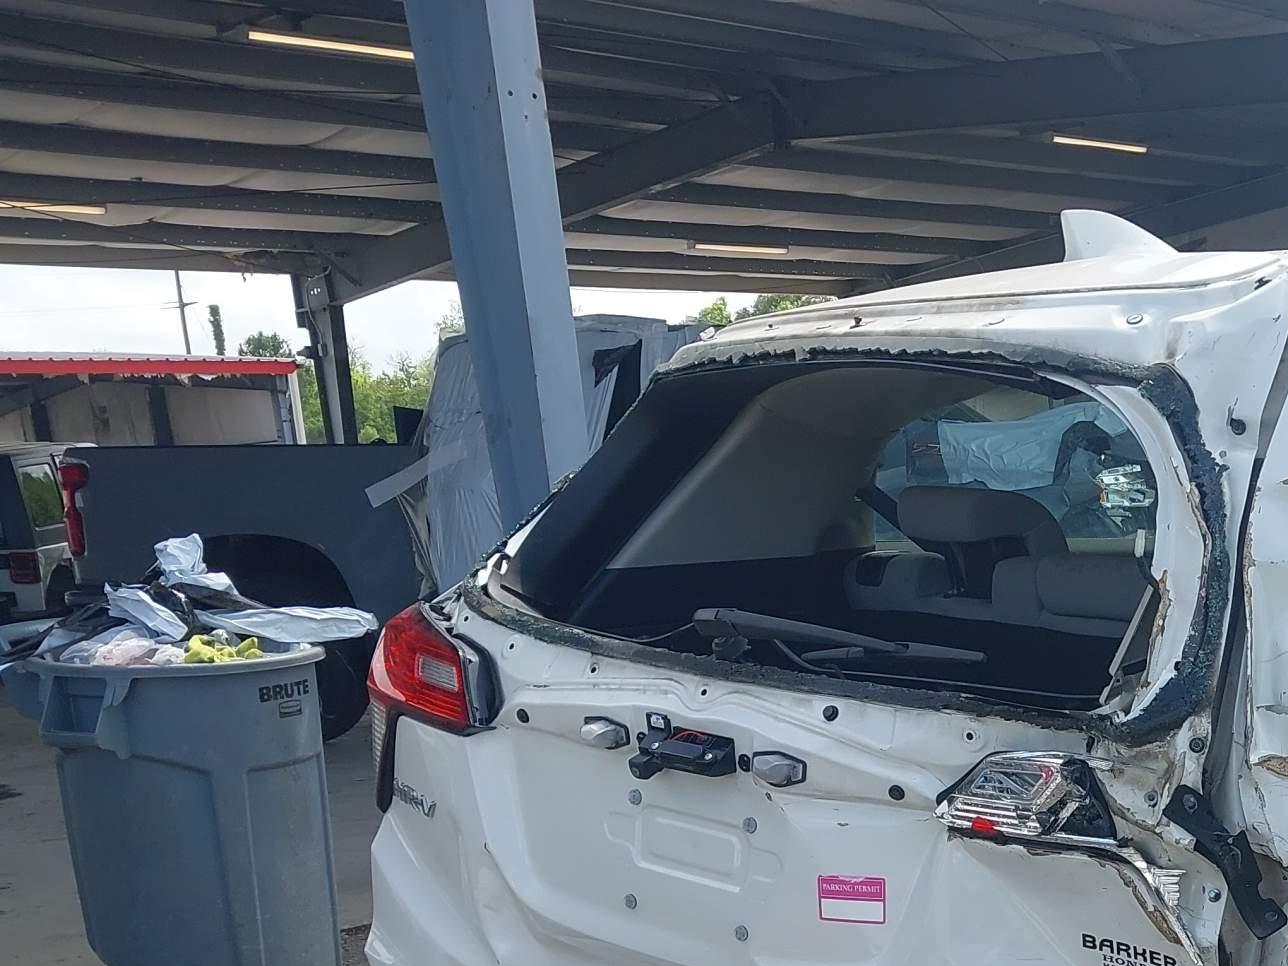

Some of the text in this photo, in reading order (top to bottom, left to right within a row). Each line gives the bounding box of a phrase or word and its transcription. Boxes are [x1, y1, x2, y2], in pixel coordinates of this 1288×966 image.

[259, 679, 309, 703] BRUTE
[823, 883, 880, 893] PARKING PERMIT
